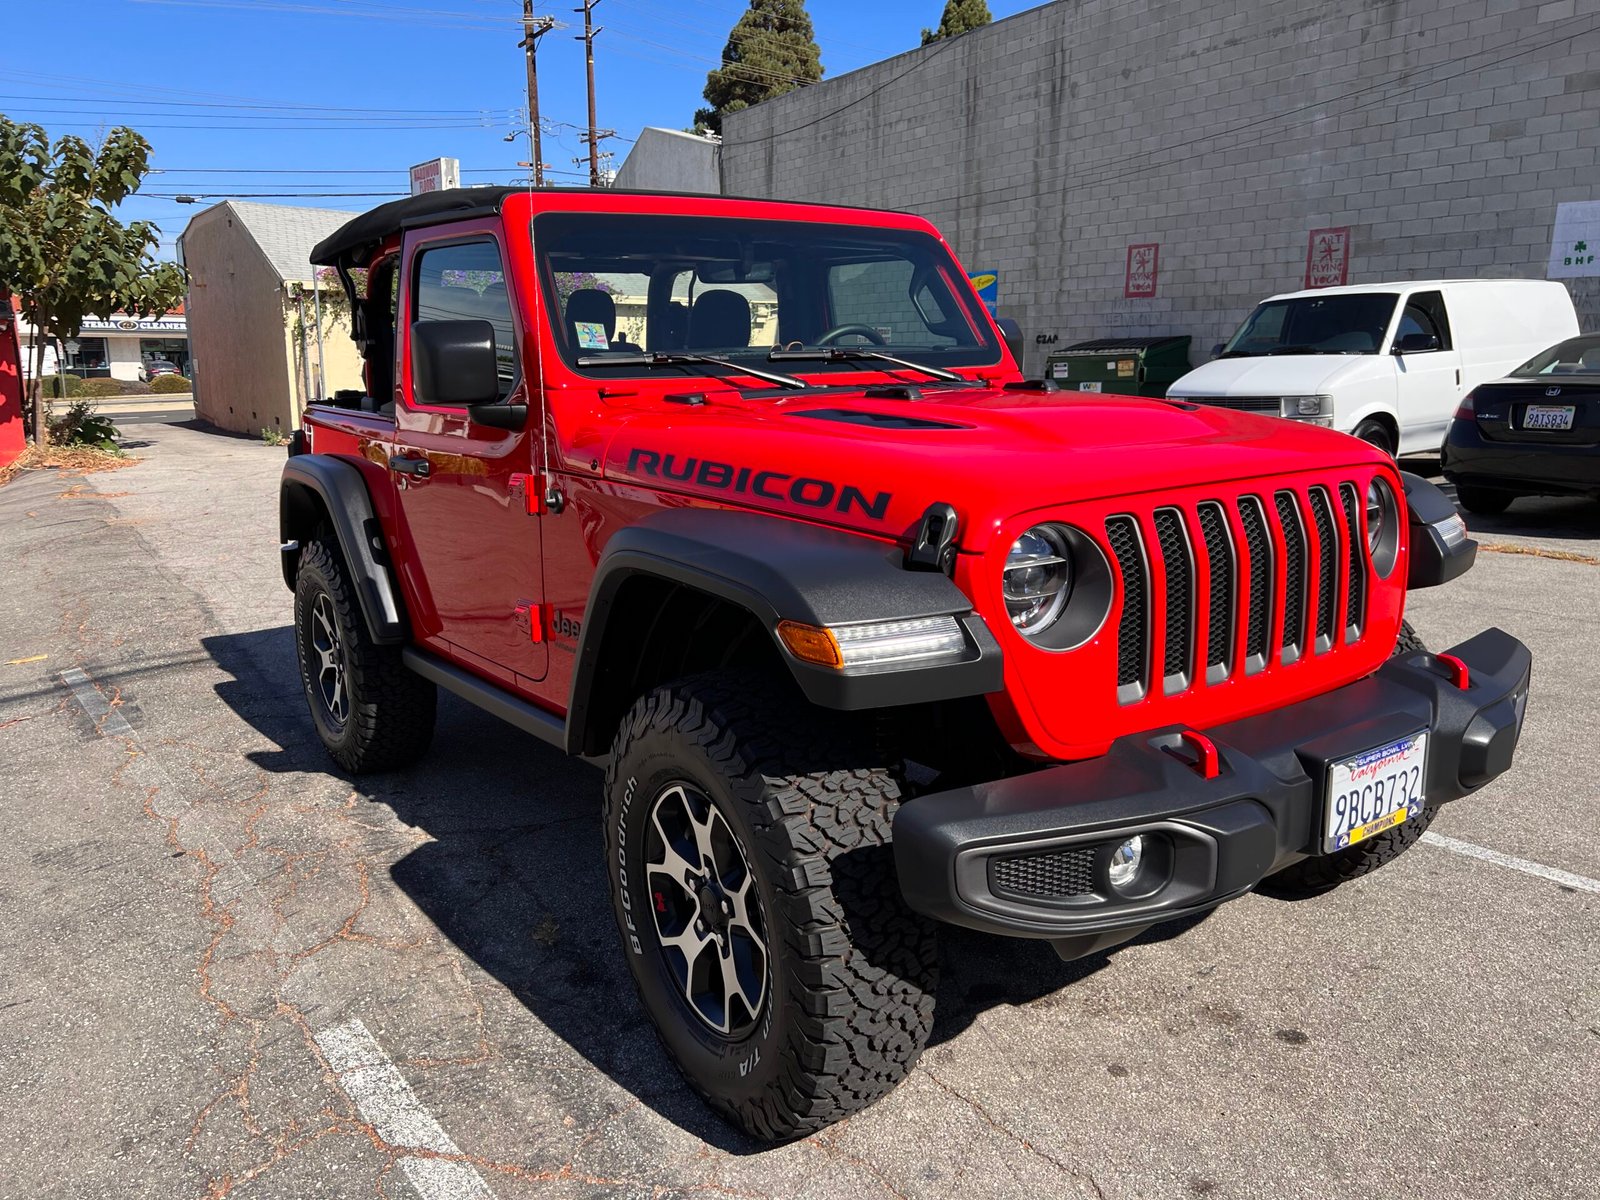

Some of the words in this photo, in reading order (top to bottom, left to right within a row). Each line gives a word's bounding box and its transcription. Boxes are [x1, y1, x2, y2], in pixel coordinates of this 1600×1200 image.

[1319, 234, 1343, 245] ART
[1312, 262, 1343, 273] FLYING
[1527, 413, 1569, 426] 9ATS834
[627, 448, 893, 520] RUBICON
[1350, 750, 1410, 782] California
[1358, 751, 1382, 766] SUPER
[1381, 745, 1401, 758] BOWL
[1335, 765, 1420, 836] 9BCB732
[1362, 814, 1396, 838] CHAMPIONS
[617, 775, 643, 955] BFGoodrich
[739, 1046, 761, 1078] T/A
